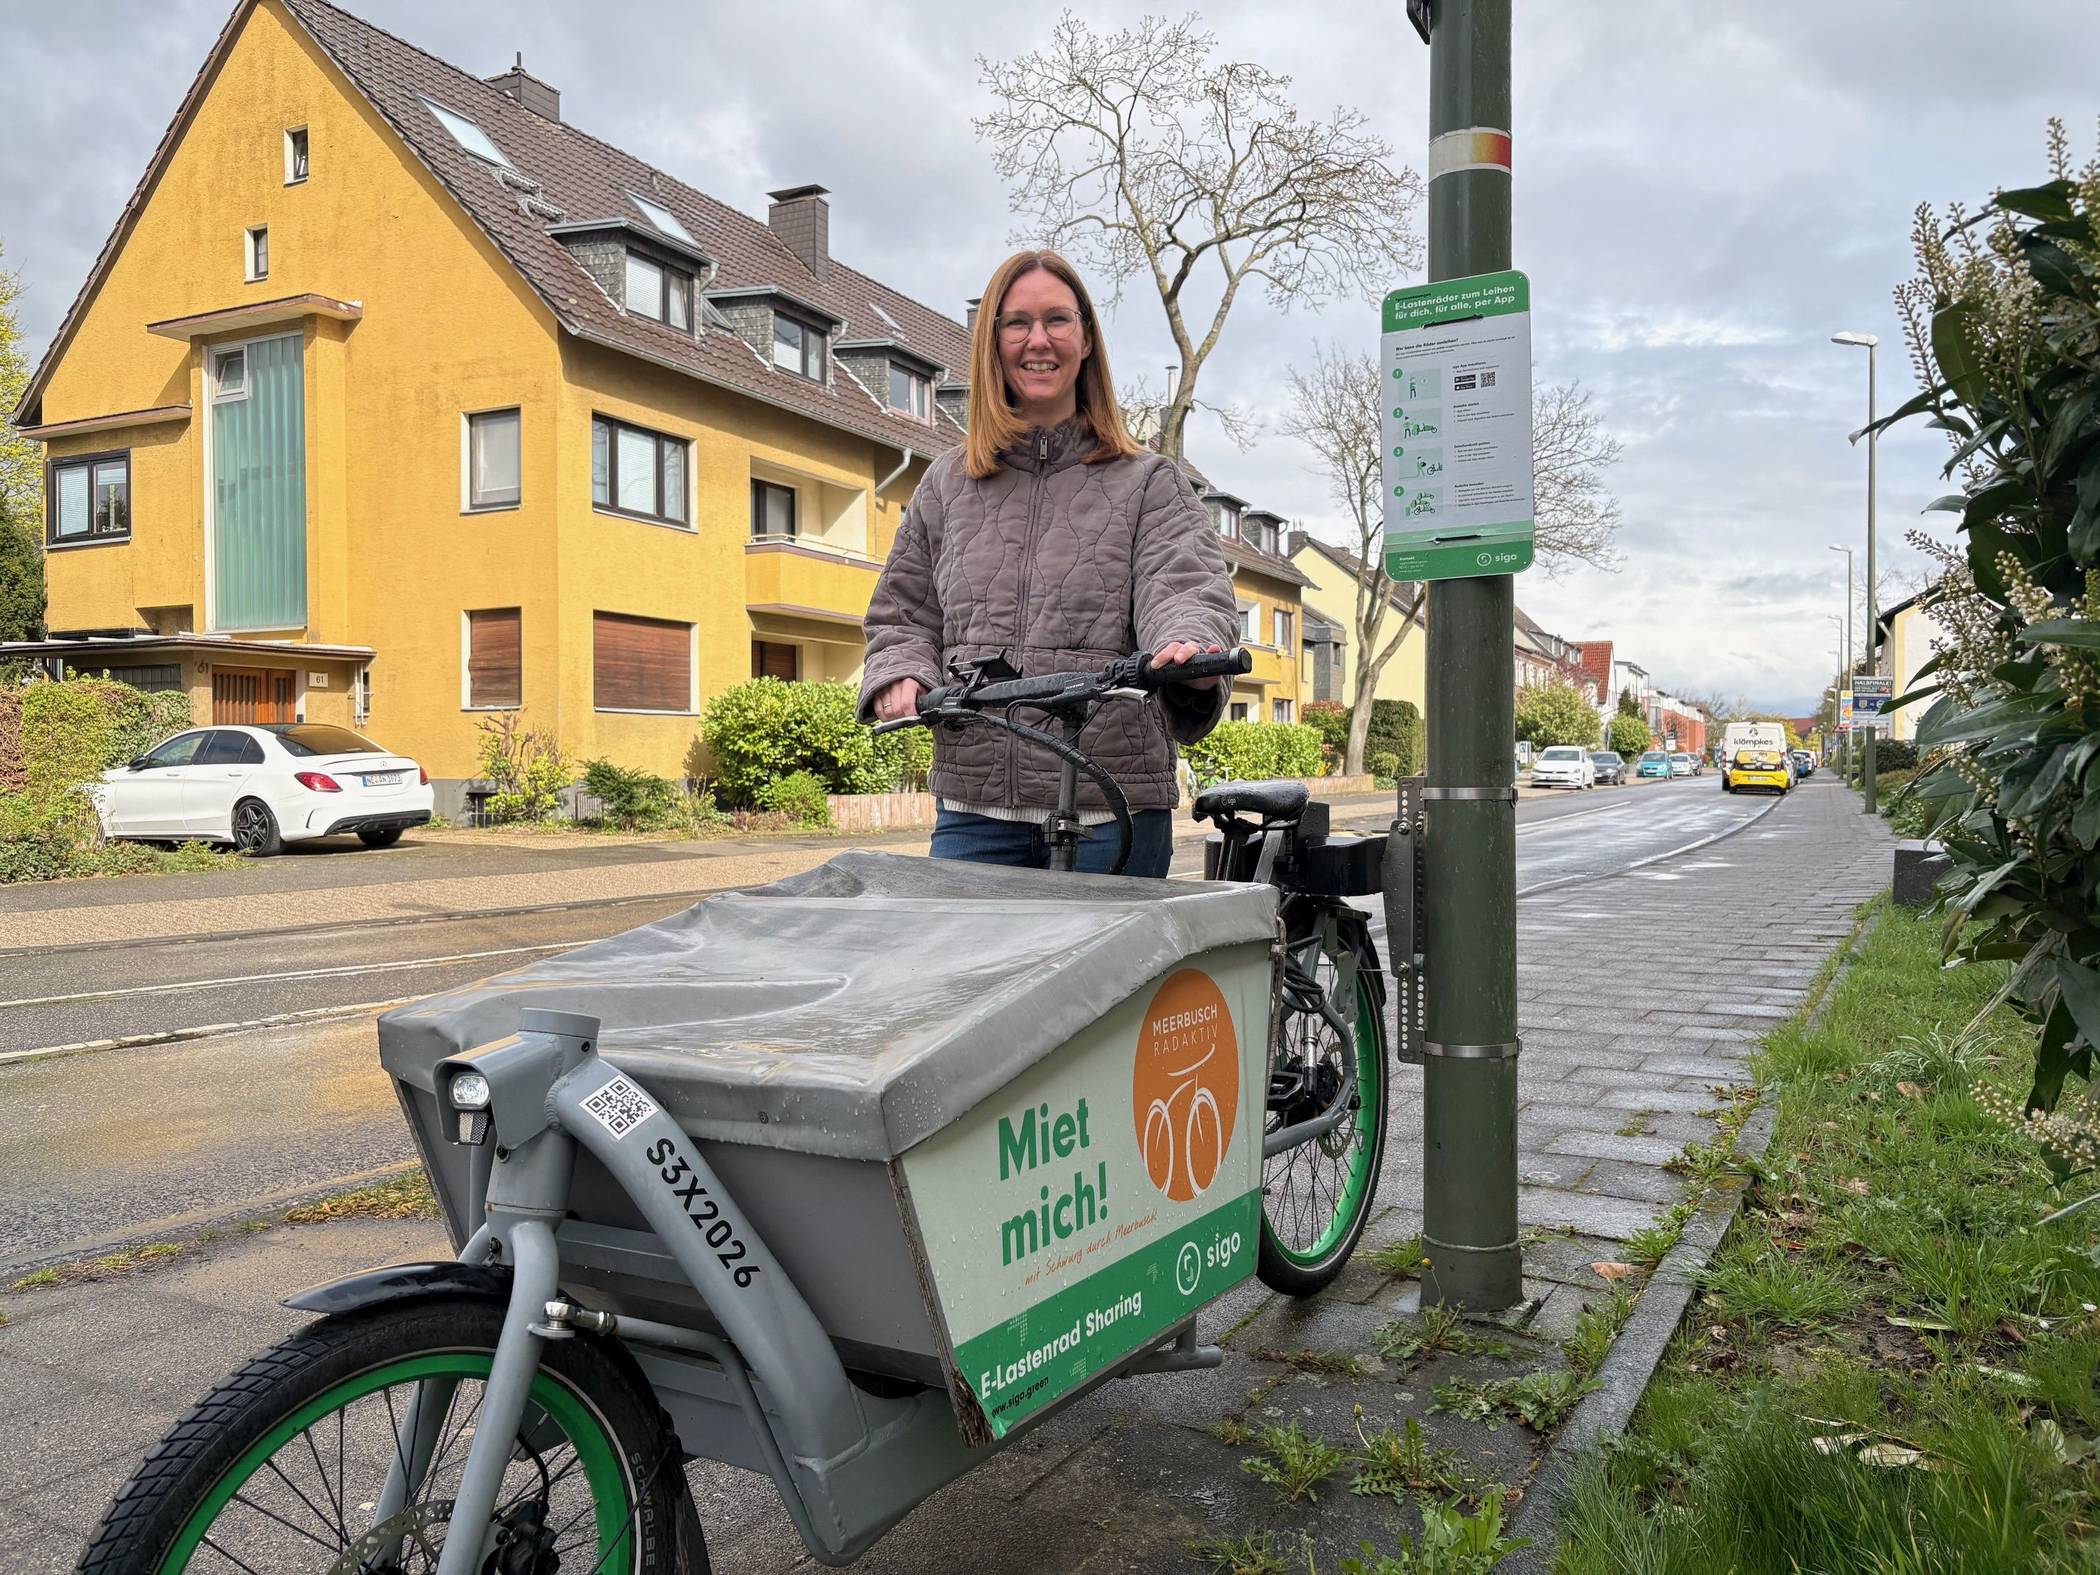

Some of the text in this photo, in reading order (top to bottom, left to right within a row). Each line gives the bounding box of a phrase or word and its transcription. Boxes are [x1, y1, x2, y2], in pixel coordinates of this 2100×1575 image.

[1395, 285, 1515, 311] E-Lastenräder zum Leihen
[1395, 312, 1408, 320] für
[1410, 307, 1432, 318] dich,
[1435, 305, 1448, 313] für
[1474, 298, 1491, 309] per
[1494, 294, 1515, 305] App
[1495, 552, 1517, 563] sigo
[316, 675, 324, 684] 61
[1733, 738, 1774, 748] klömpkes
[1152, 1003, 1218, 1037] MEERBUSCH
[1154, 1023, 1218, 1057] RADAKTIV
[997, 1097, 1091, 1181] Miet
[646, 1138, 761, 1288] S3X2026
[1001, 1161, 1108, 1267] mich!
[1025, 1265, 1041, 1286] mit
[1046, 1246, 1084, 1276] Schwung
[1087, 1230, 1111, 1254] durch
[1206, 1230, 1241, 1269] sigo
[980, 1290, 1142, 1400] E-Lastenrad Sharing
